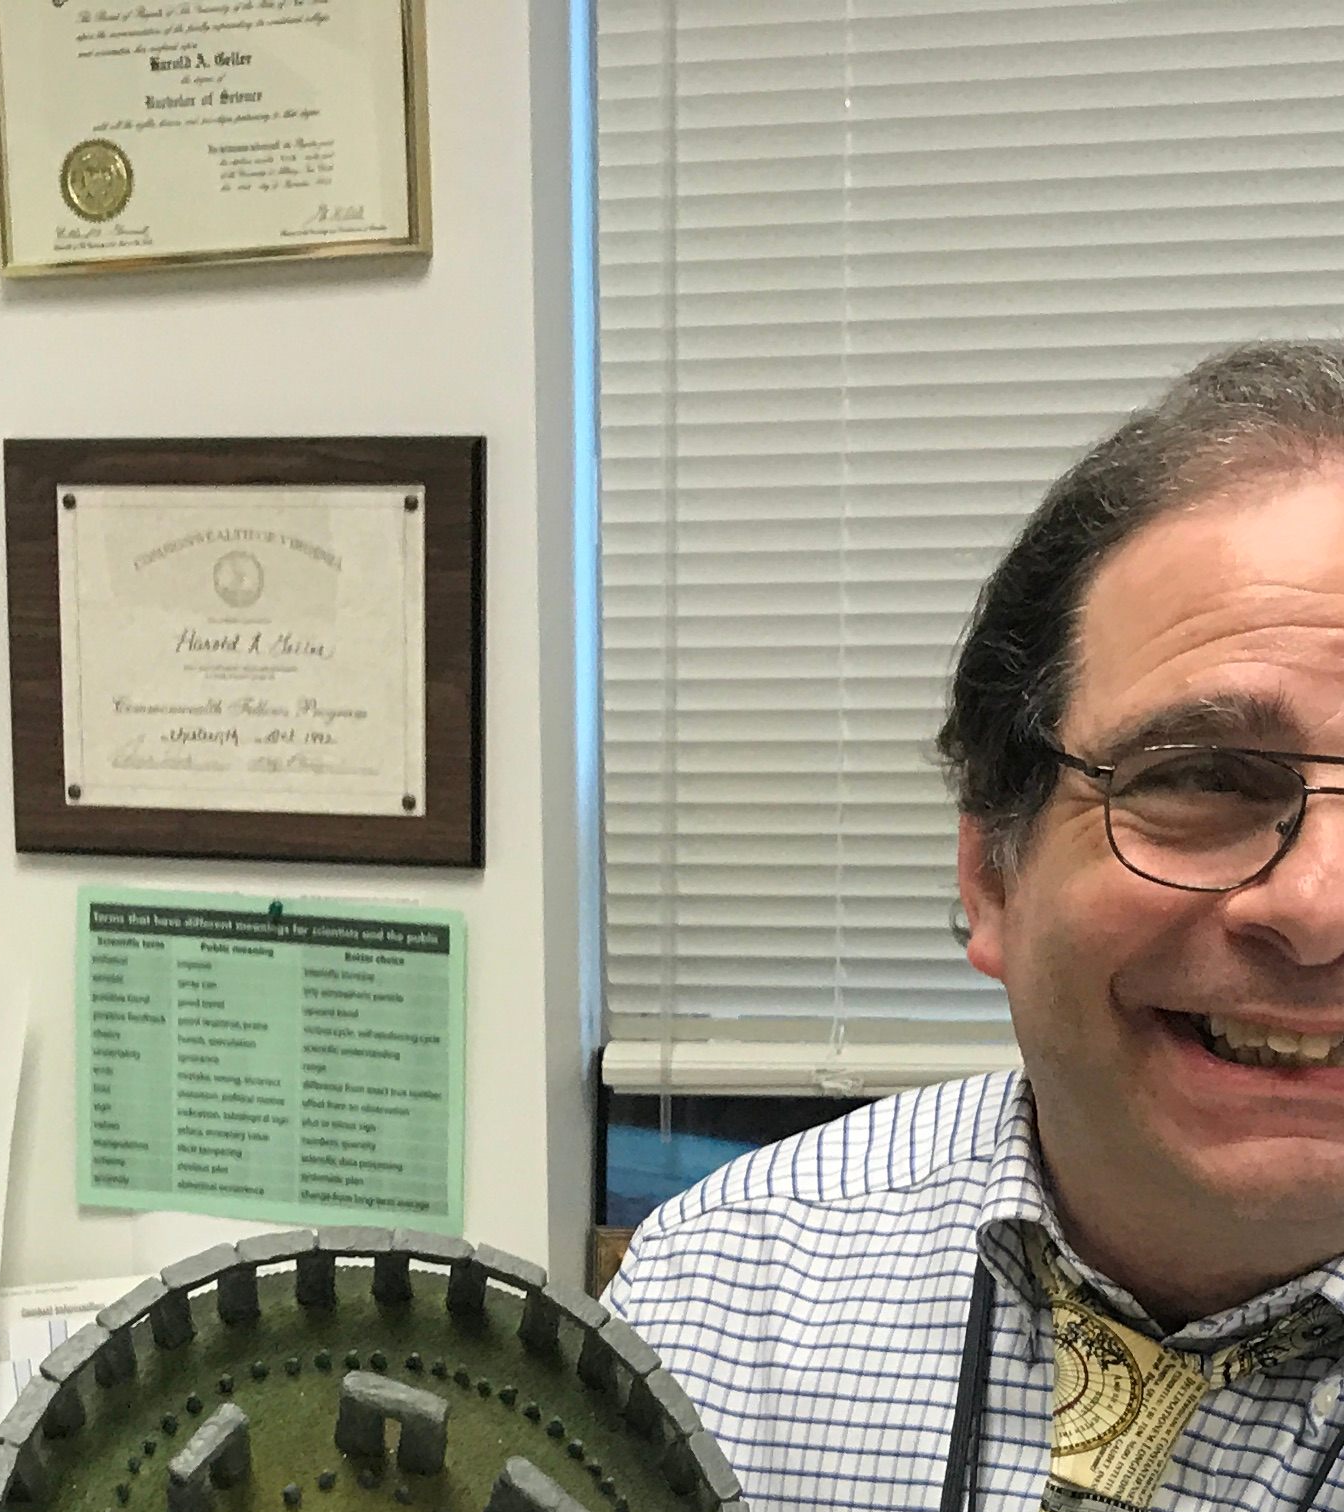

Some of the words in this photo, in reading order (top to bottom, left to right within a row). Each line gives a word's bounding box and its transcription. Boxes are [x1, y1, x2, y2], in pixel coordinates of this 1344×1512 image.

[93, 911, 124, 924] Terms
[128, 912, 150, 926] that
[153, 913, 182, 928] have
[184, 916, 233, 931] different
[312, 926, 359, 941] scientists
[362, 928, 384, 943] and
[386, 929, 404, 943] the
[406, 931, 440, 946] public
